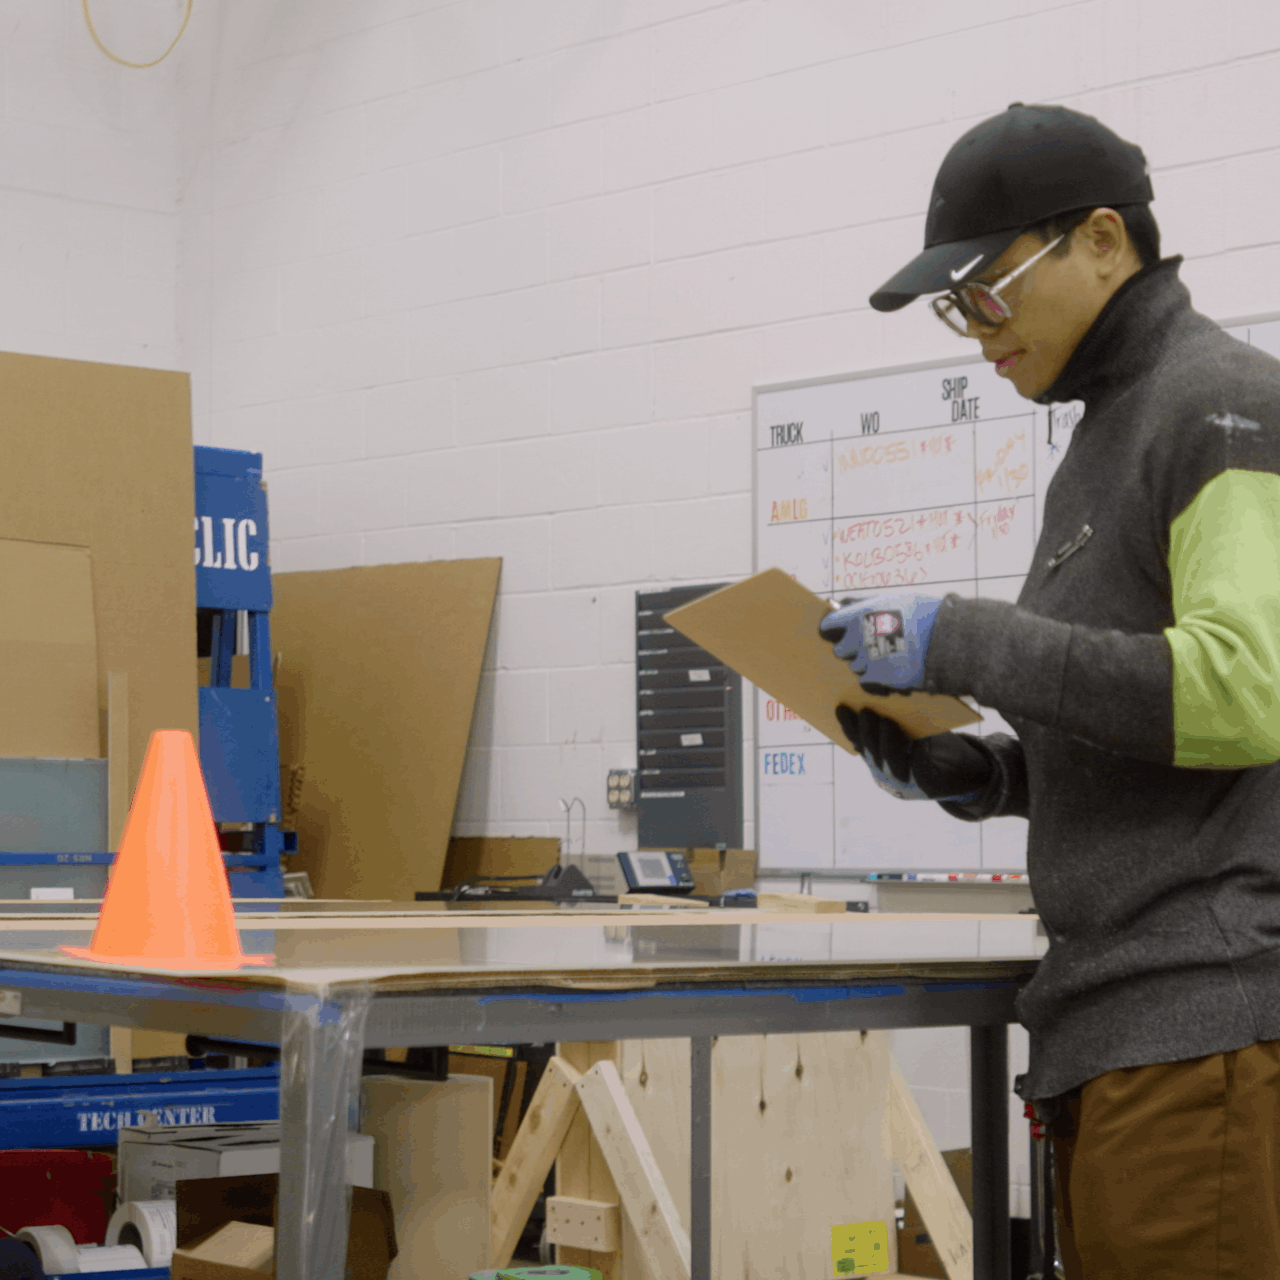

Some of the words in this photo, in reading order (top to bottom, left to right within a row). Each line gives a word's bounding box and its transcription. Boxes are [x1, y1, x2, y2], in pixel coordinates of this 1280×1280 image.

[942, 376, 968, 400] SHIP
[951, 397, 980, 422] DATE
[770, 422, 804, 447] TRUCK
[860, 411, 880, 434] WO
[765, 752, 806, 776] FEDEX
[77, 1110, 132, 1132] TECH
